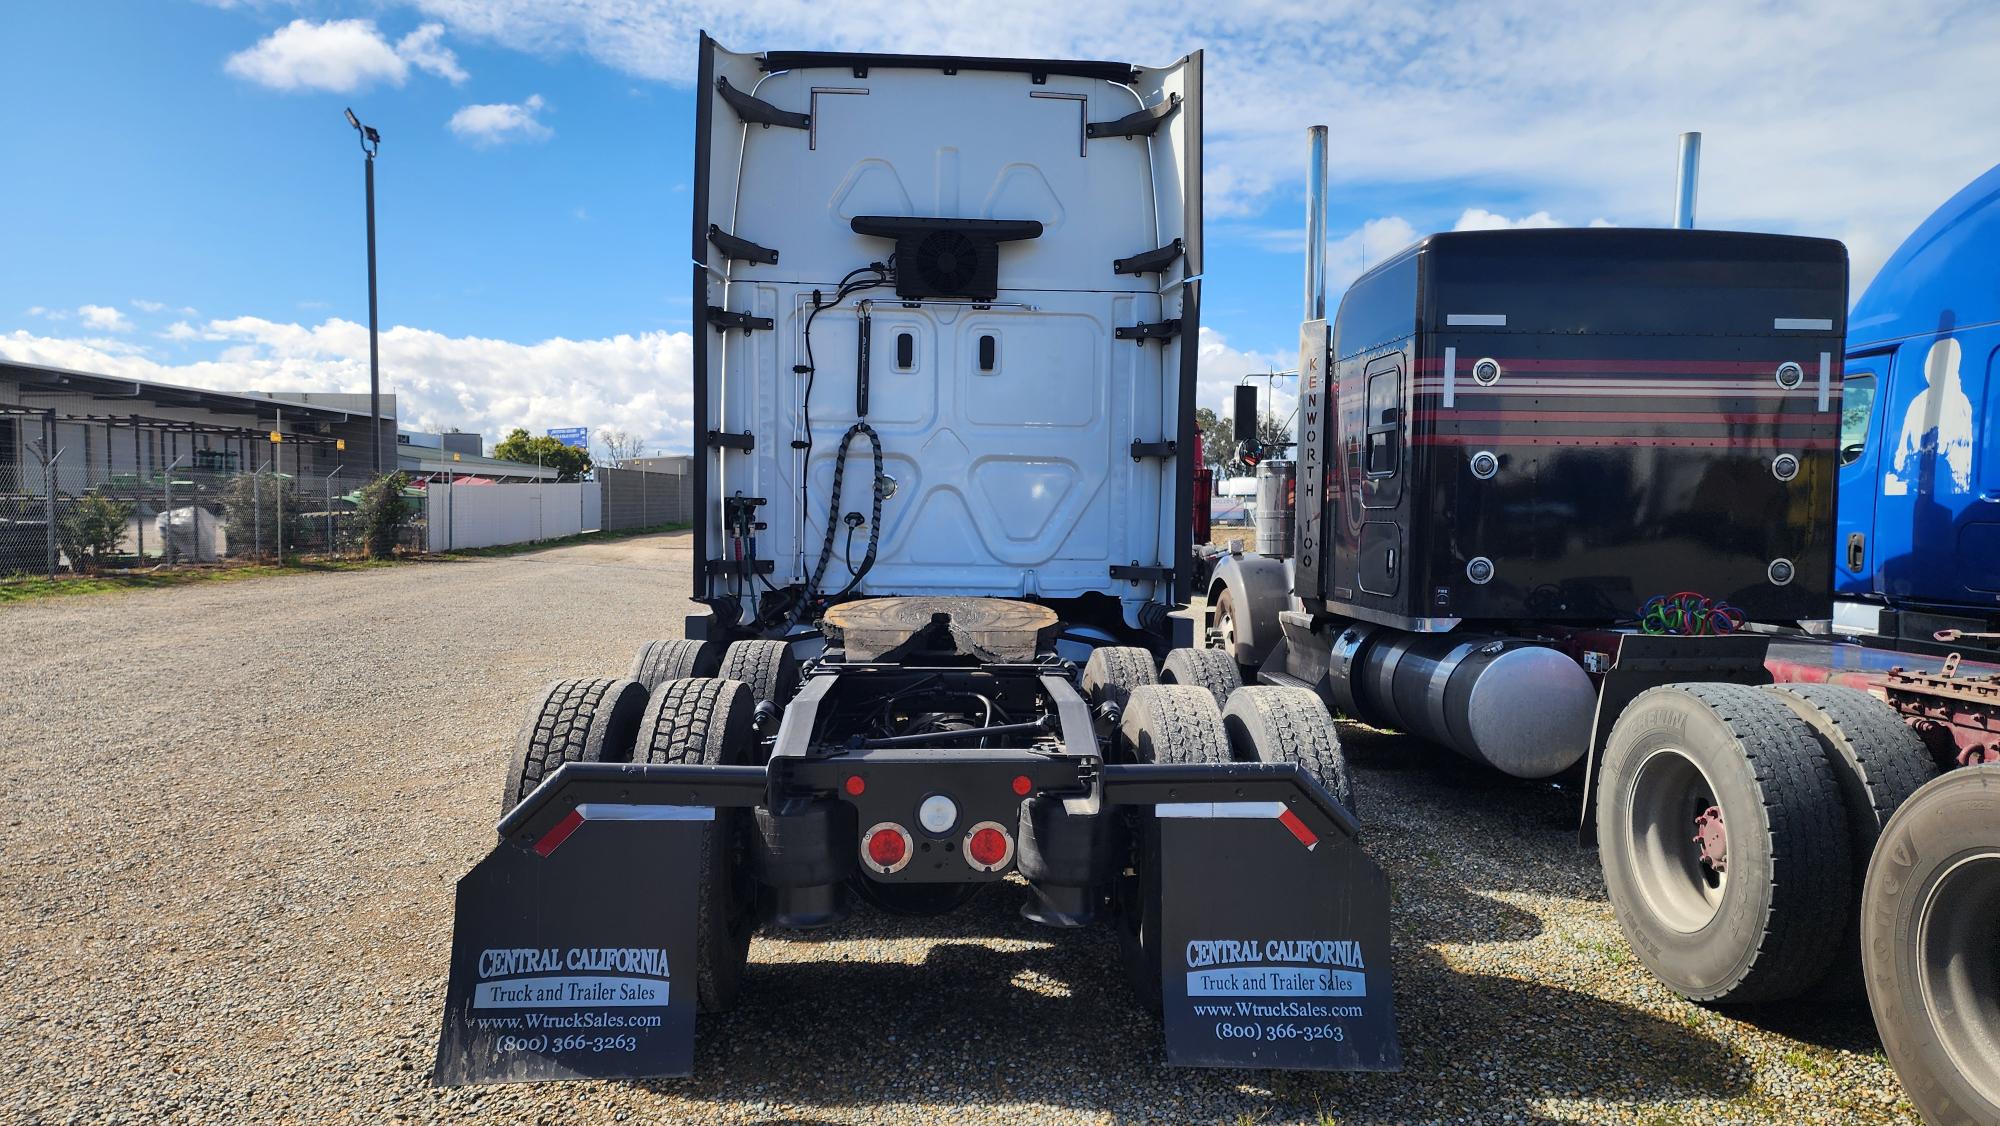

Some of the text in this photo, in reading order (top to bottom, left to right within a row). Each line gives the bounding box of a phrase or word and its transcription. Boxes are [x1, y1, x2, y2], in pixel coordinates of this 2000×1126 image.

[1302, 357, 1318, 568] KENWORTH 100
[478, 948, 670, 978] CENTRAL CALIFORNIA
[1186, 940, 1365, 969] CENTRAL CALIFORNIA
[490, 982, 655, 1002] Truck and Trailer Sales
[1200, 973, 1353, 991] Truck and Trailer Sales
[1193, 1002, 1363, 1017] www.WtruckSales.com
[477, 1012, 662, 1030] www.WtruckSales.com
[1215, 1023, 1344, 1042] (800) 366-3263
[496, 1033, 636, 1054] (800) 366-3263
